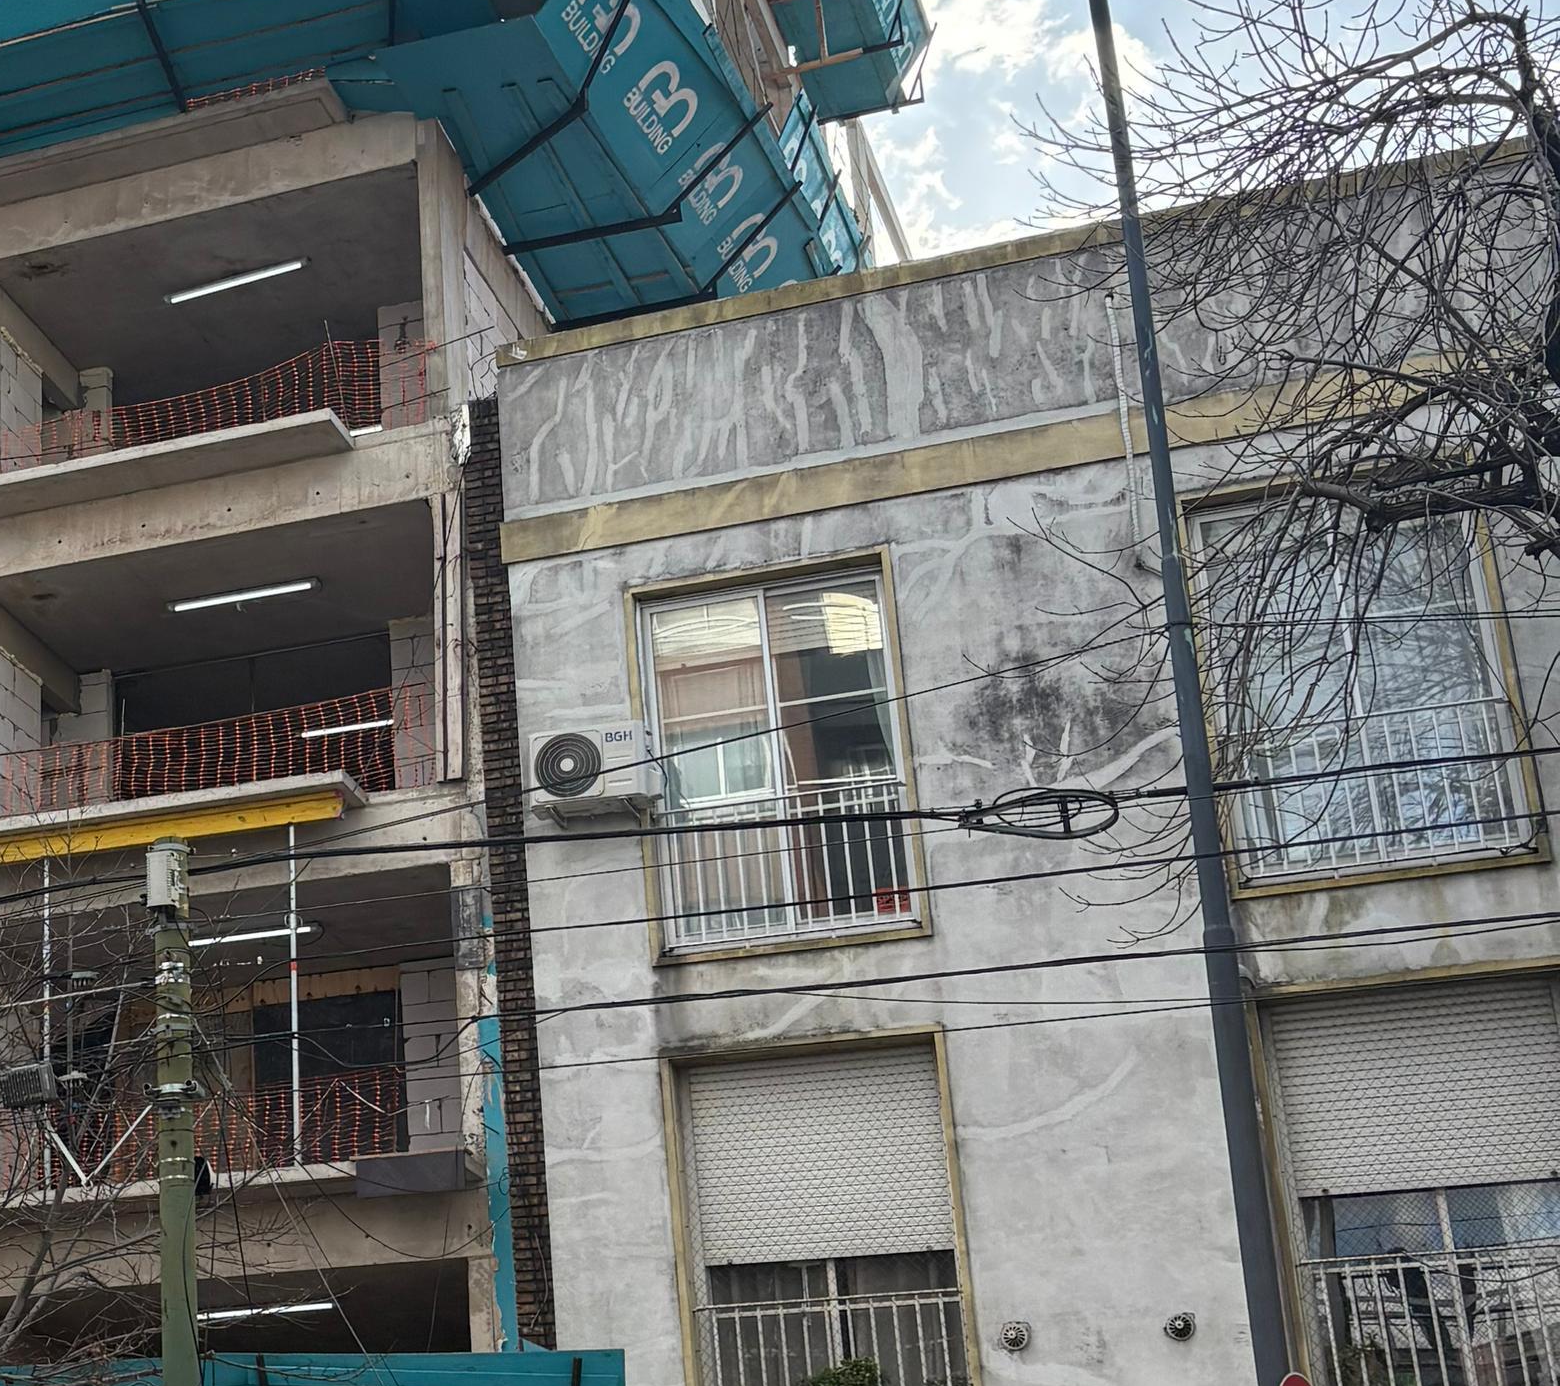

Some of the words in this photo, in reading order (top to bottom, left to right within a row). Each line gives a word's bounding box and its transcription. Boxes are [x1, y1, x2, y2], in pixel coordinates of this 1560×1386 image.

[623, 87, 672, 155] BUILDING
[639, 60, 699, 138] GO
[605, 730, 633, 743] BGH
